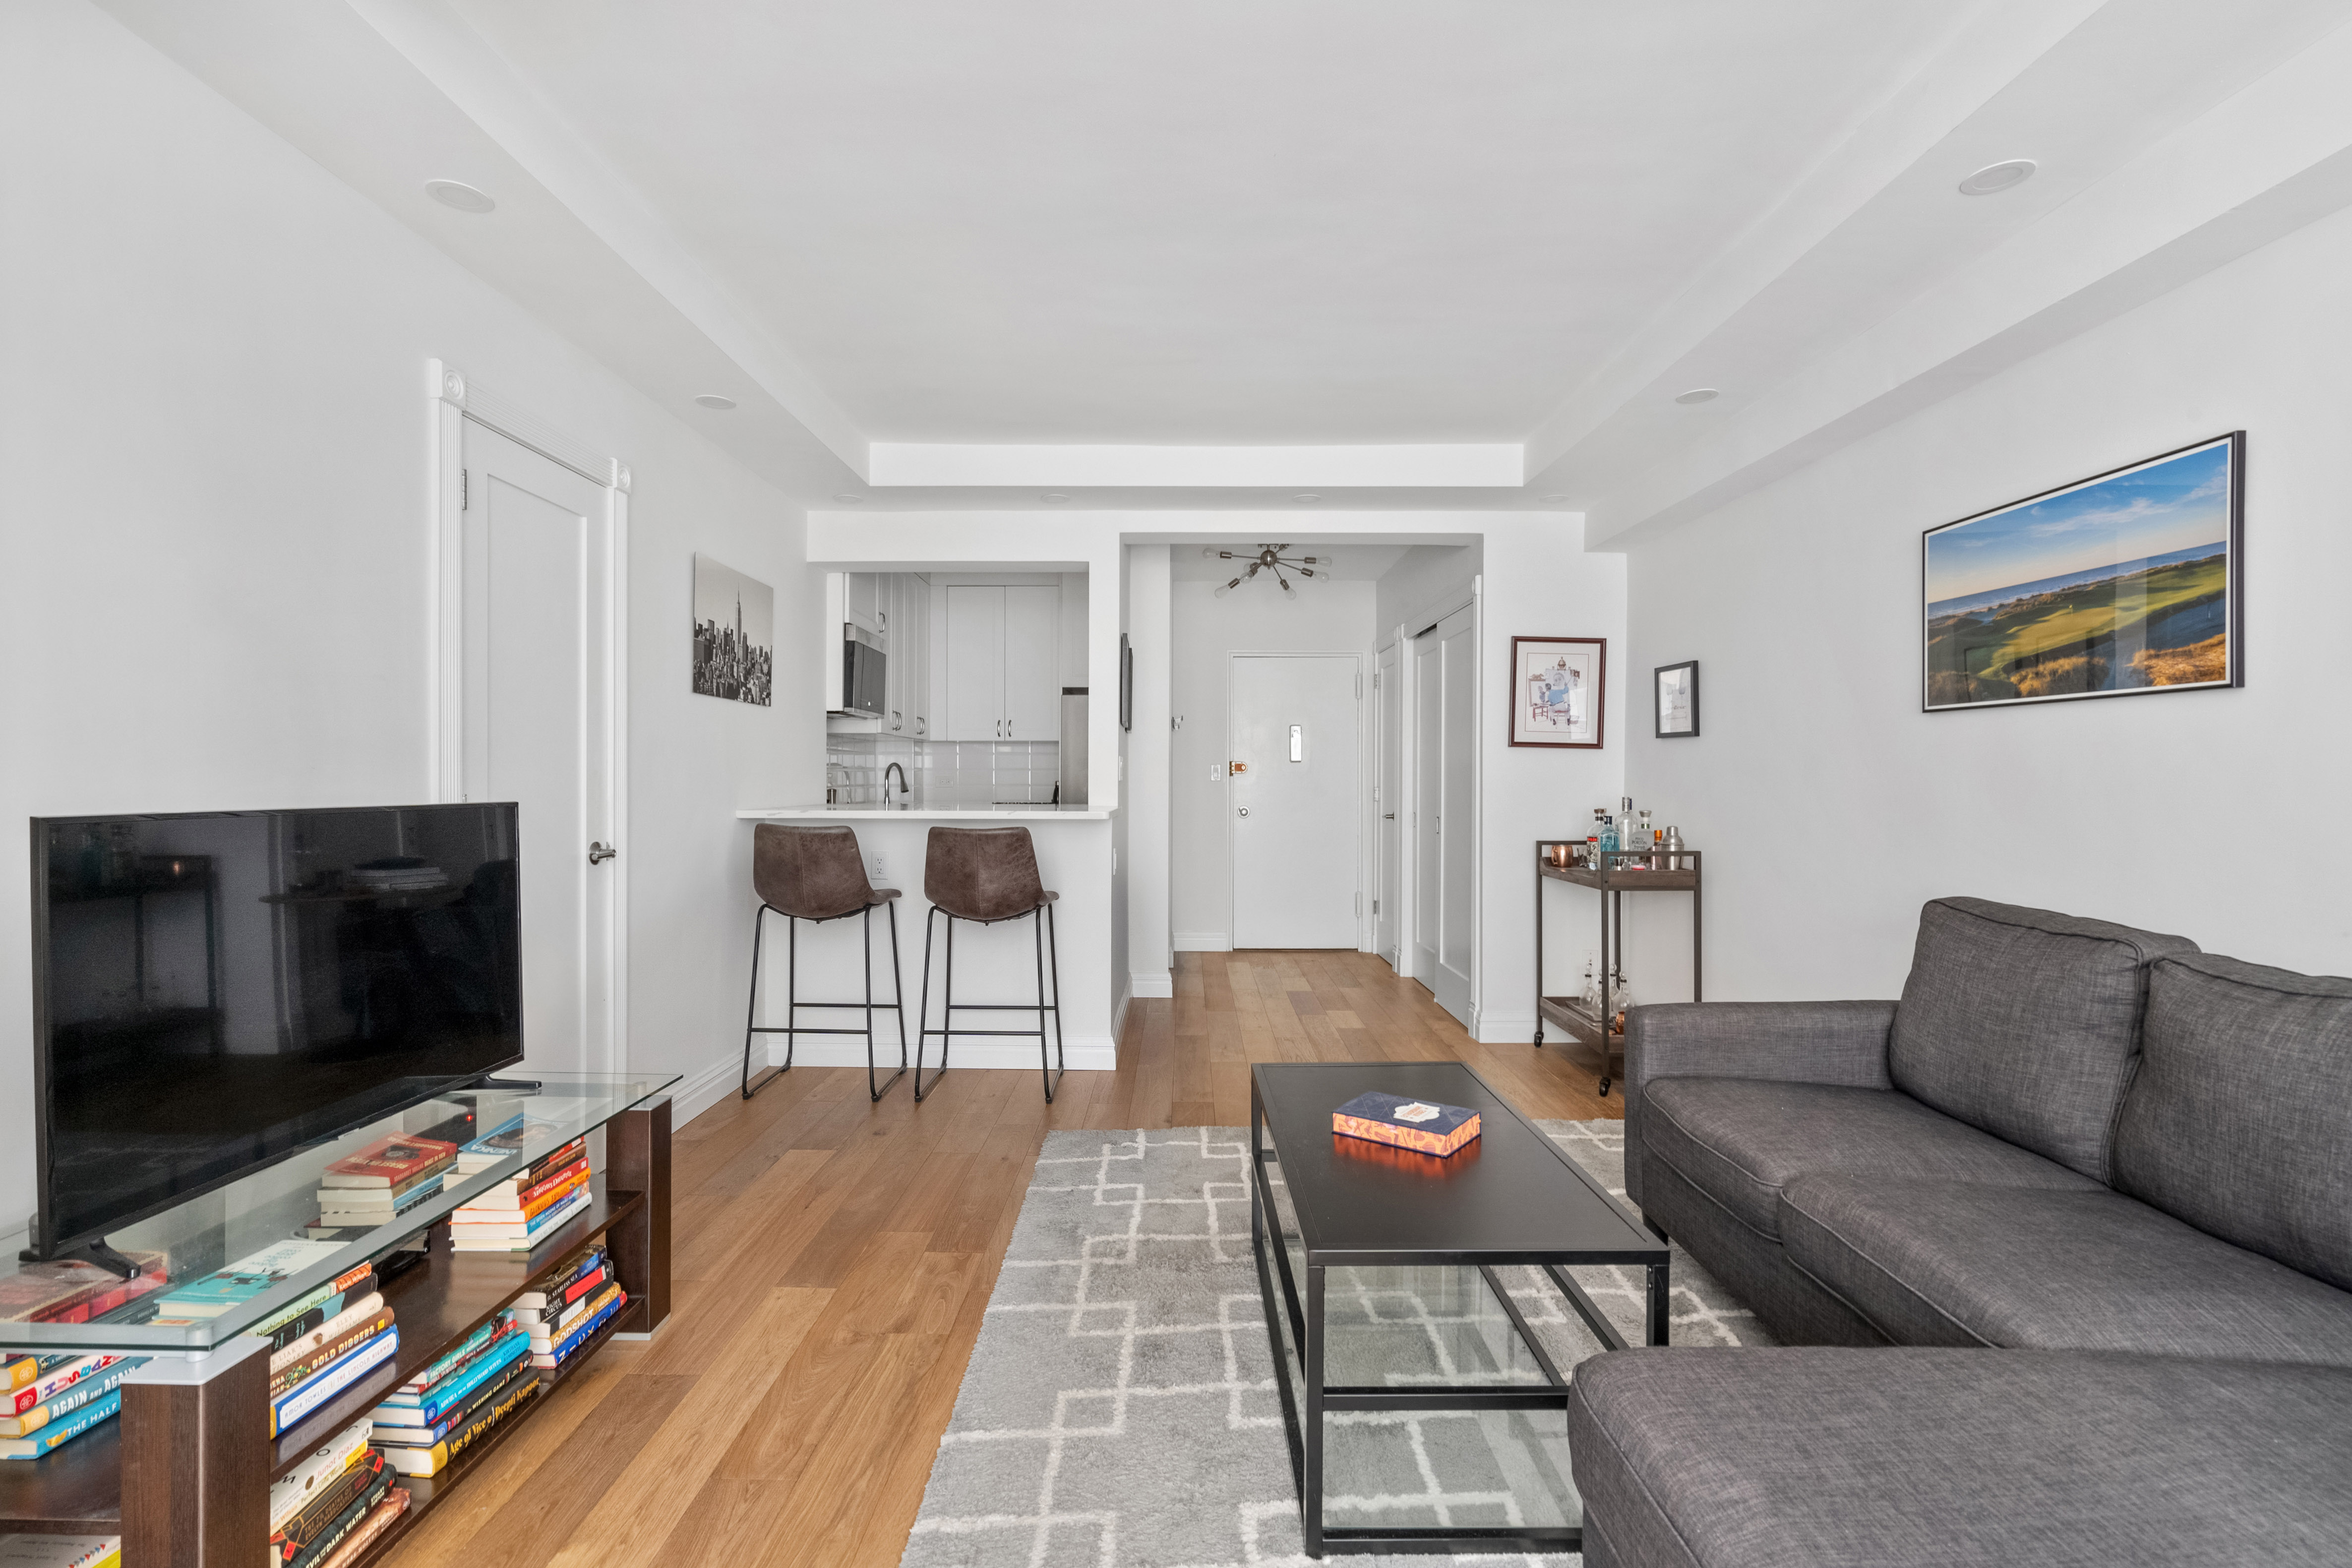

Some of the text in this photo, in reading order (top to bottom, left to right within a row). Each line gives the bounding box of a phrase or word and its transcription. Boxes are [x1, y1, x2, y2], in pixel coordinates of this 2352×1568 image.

[339, 1271, 367, 1290] Kevin Wilson
[552, 1279, 571, 1298] STARLESS
[257, 1319, 285, 1337] Nothing
[297, 1305, 308, 1316] See
[311, 1295, 326, 1306] Here
[336, 1314, 353, 1328] ELEY
[545, 1303, 562, 1317] CIRCUS
[546, 1298, 561, 1311] NIGHT
[329, 1317, 362, 1340] WILLIAMS
[553, 1308, 594, 1348] GODSHOT
[272, 1350, 306, 1372] TIONARY
[279, 1343, 303, 1362] LIAR'S
[312, 1348, 336, 1370] GOLD
[338, 1325, 375, 1354] DIGGERS
[430, 1359, 451, 1378] FACTORY
[451, 1349, 465, 1363] GIRLS
[284, 1340, 393, 1418] AMOR TOWLES THE LINCOLN HIGHWAY
[440, 1392, 457, 1409] ADVIKA
[488, 1358, 502, 1374] WIVES
[472, 1390, 492, 1410] WISHING
[493, 1379, 505, 1393] GAME
[52, 1389, 87, 1419] AGAIN
[89, 1387, 103, 1400] AND
[66, 1402, 118, 1437] THE HALF
[450, 1376, 541, 1460] Age of Vice Deepti Kapoor
[316, 1442, 354, 1481] Junot Díaz
[270, 1463, 344, 1532] vin Wilson Perfect Little World
[304, 1523, 315, 1534] THE
[325, 1496, 345, 1513] DEATHS
[344, 1485, 353, 1496] OF
[371, 1486, 385, 1503] STUART
[305, 1493, 353, 1540] EVELYN HARDCASTLE
[326, 1528, 345, 1553] DARK
[346, 1506, 366, 1532] WATER
